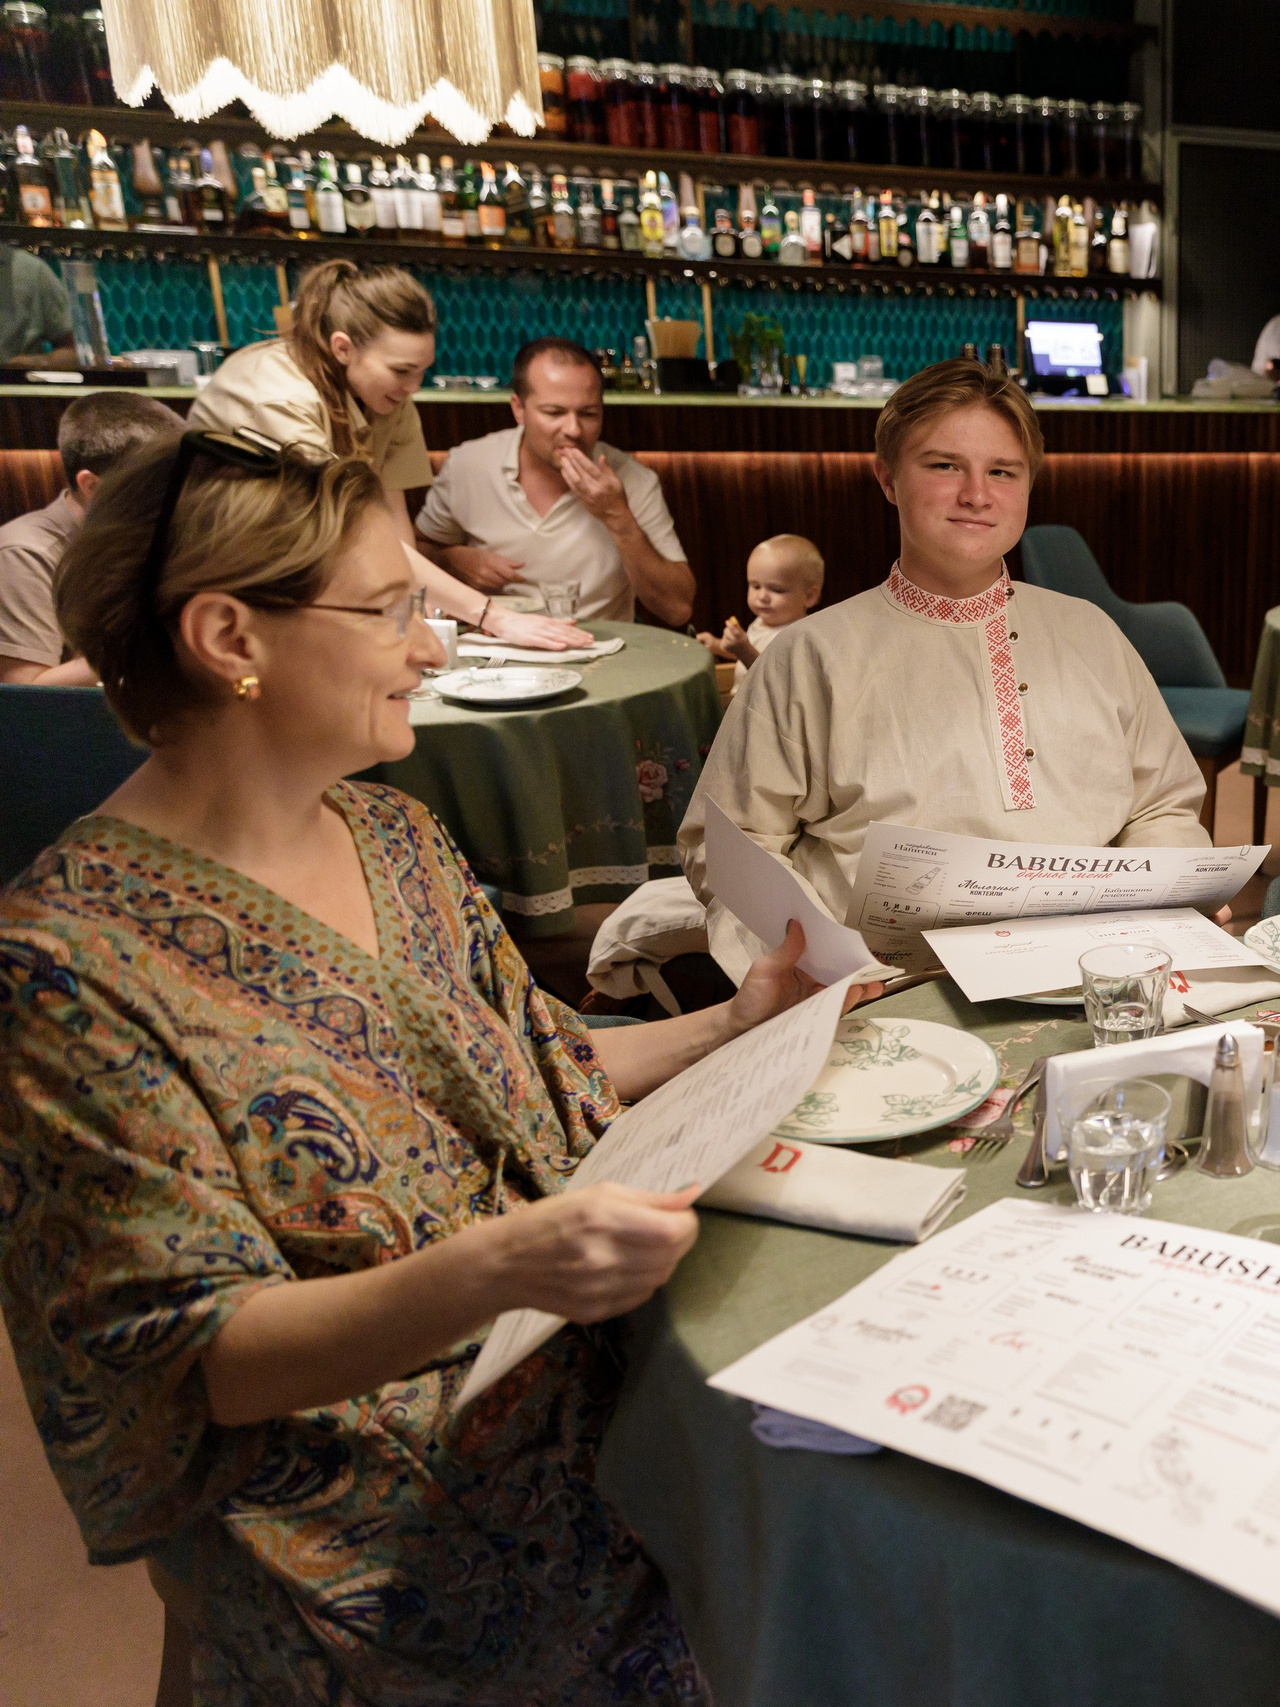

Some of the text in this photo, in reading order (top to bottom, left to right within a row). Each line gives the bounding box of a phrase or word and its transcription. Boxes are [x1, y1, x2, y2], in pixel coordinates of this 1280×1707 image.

[1016, 866, 1114, 881] барное меню
[957, 880, 1020, 892] Молочные
